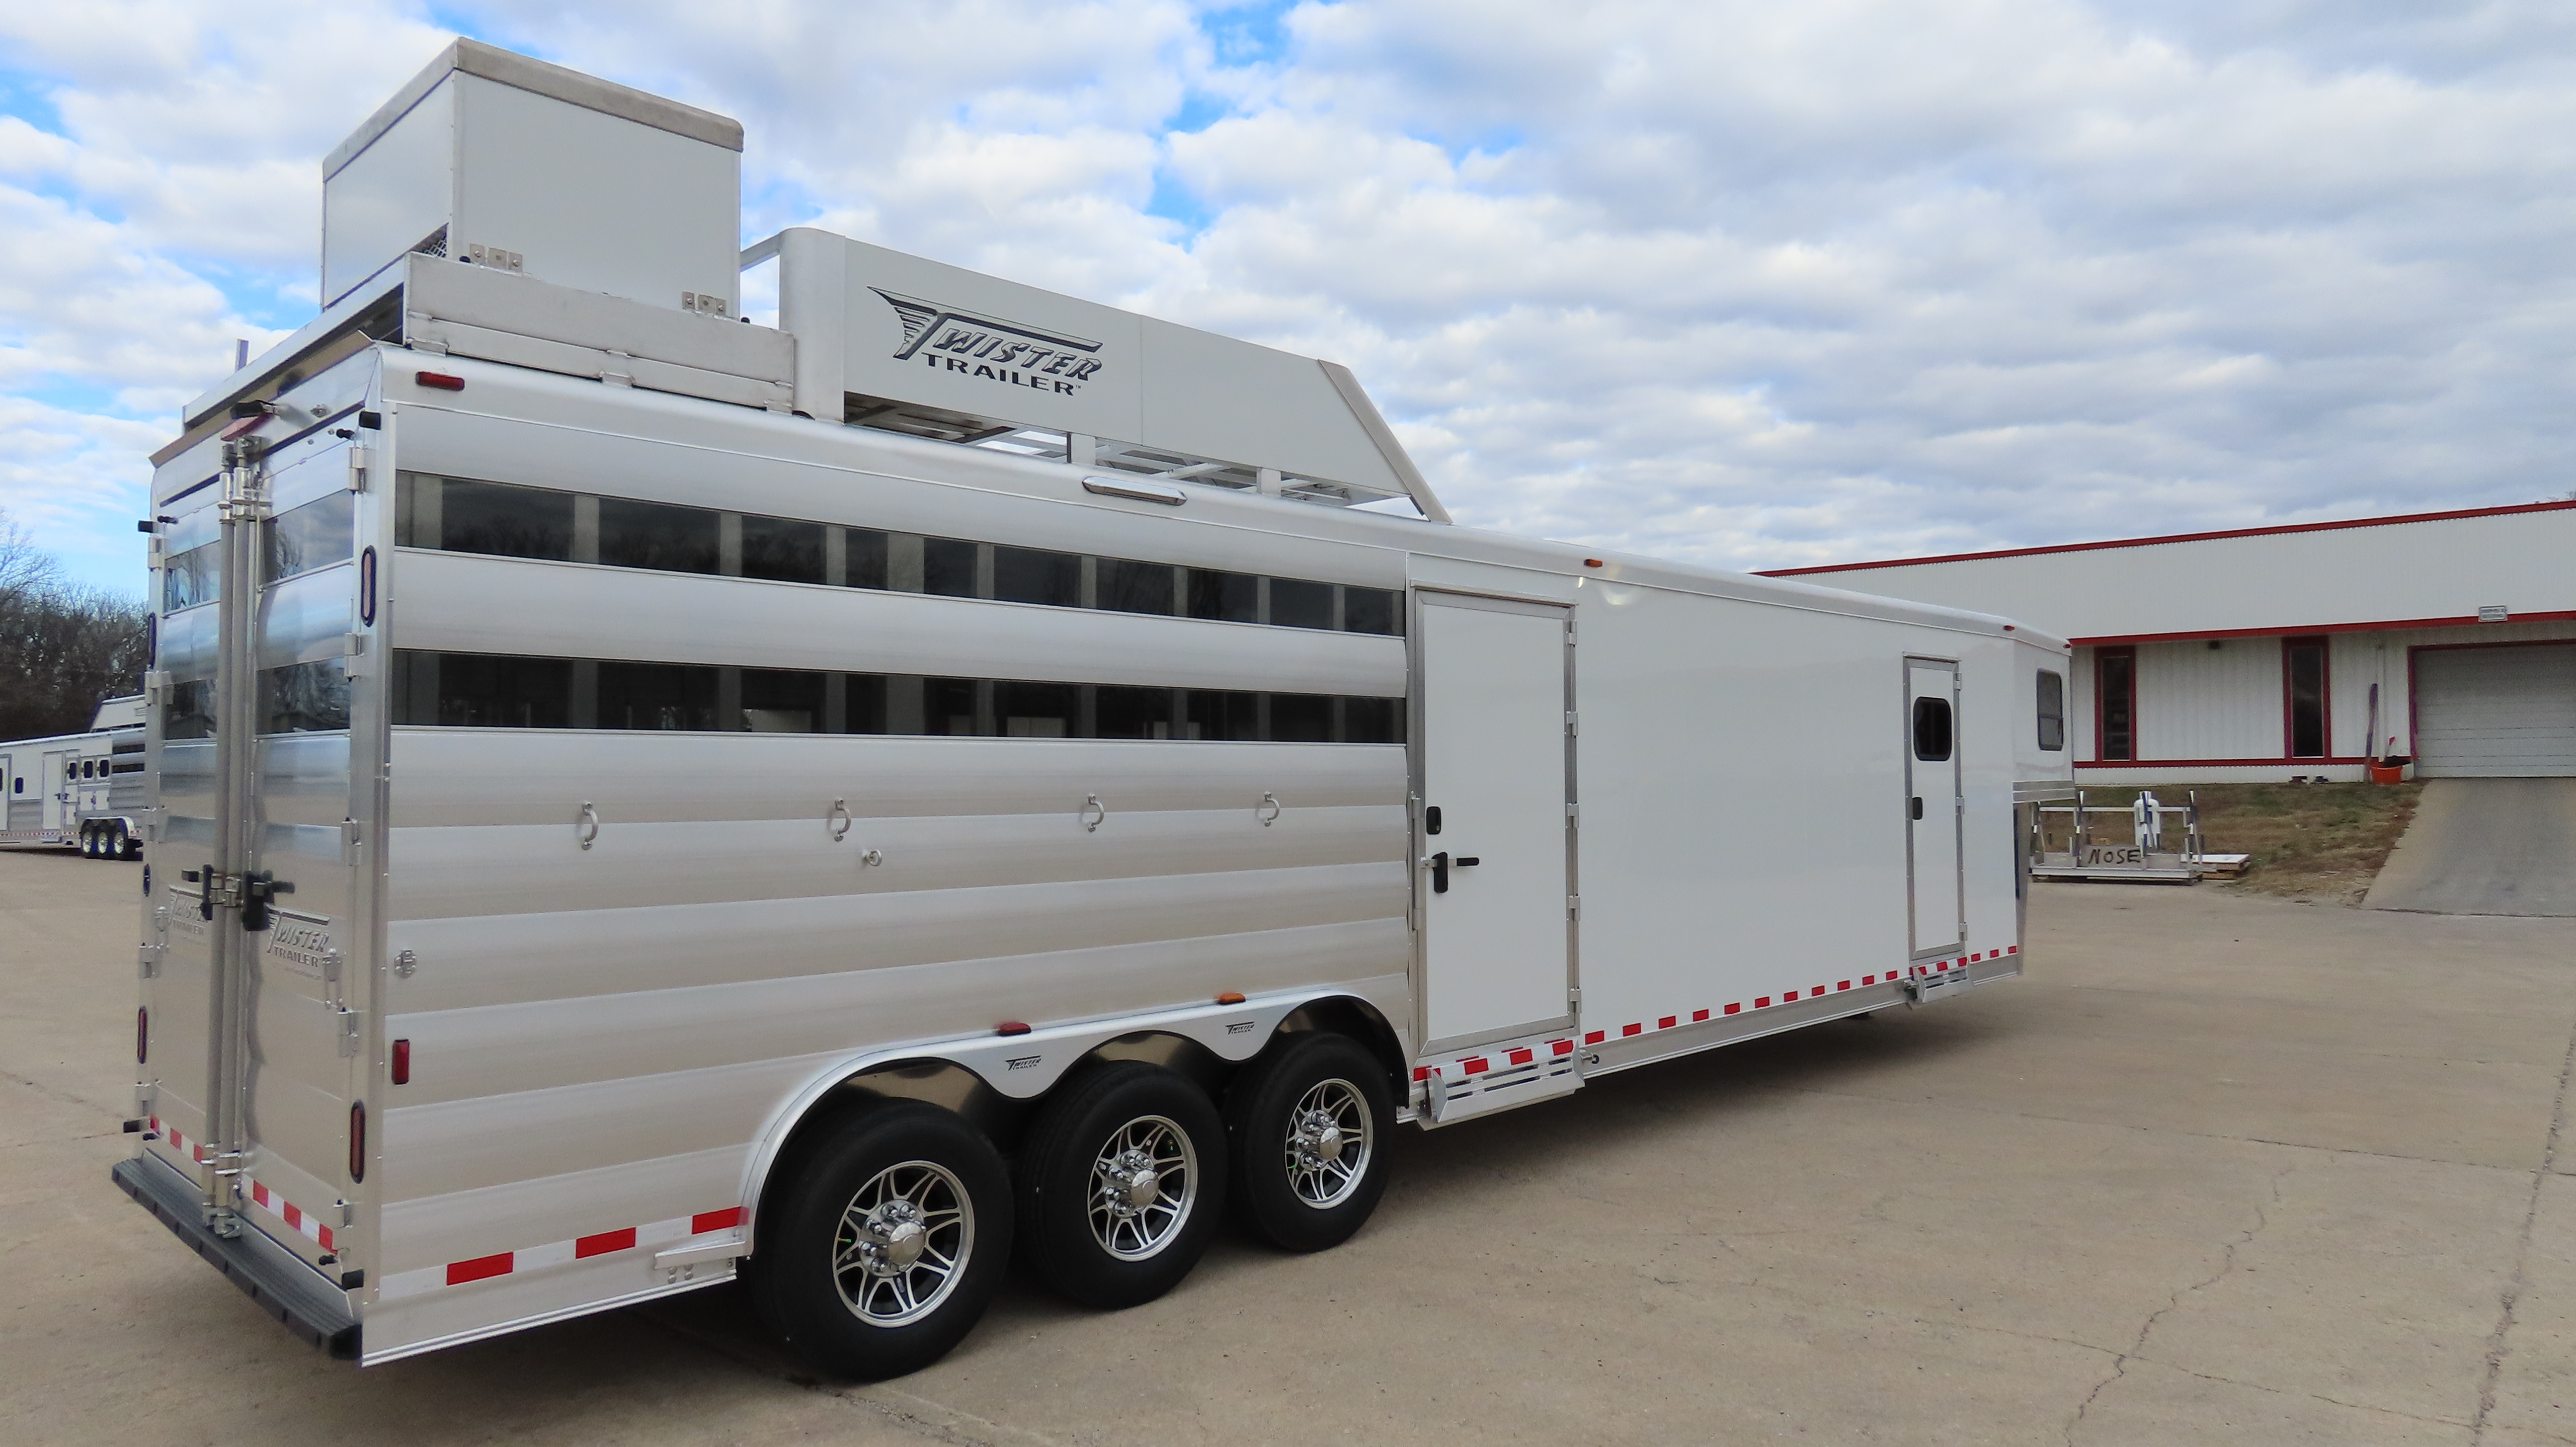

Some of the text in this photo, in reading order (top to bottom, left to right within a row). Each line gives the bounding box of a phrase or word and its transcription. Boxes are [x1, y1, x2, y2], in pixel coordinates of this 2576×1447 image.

[867, 285, 1103, 381] TWISTER
[921, 352, 1074, 396] TRAILER
[2088, 848, 2141, 864] NOSE
[274, 945, 318, 967] TRAILER
